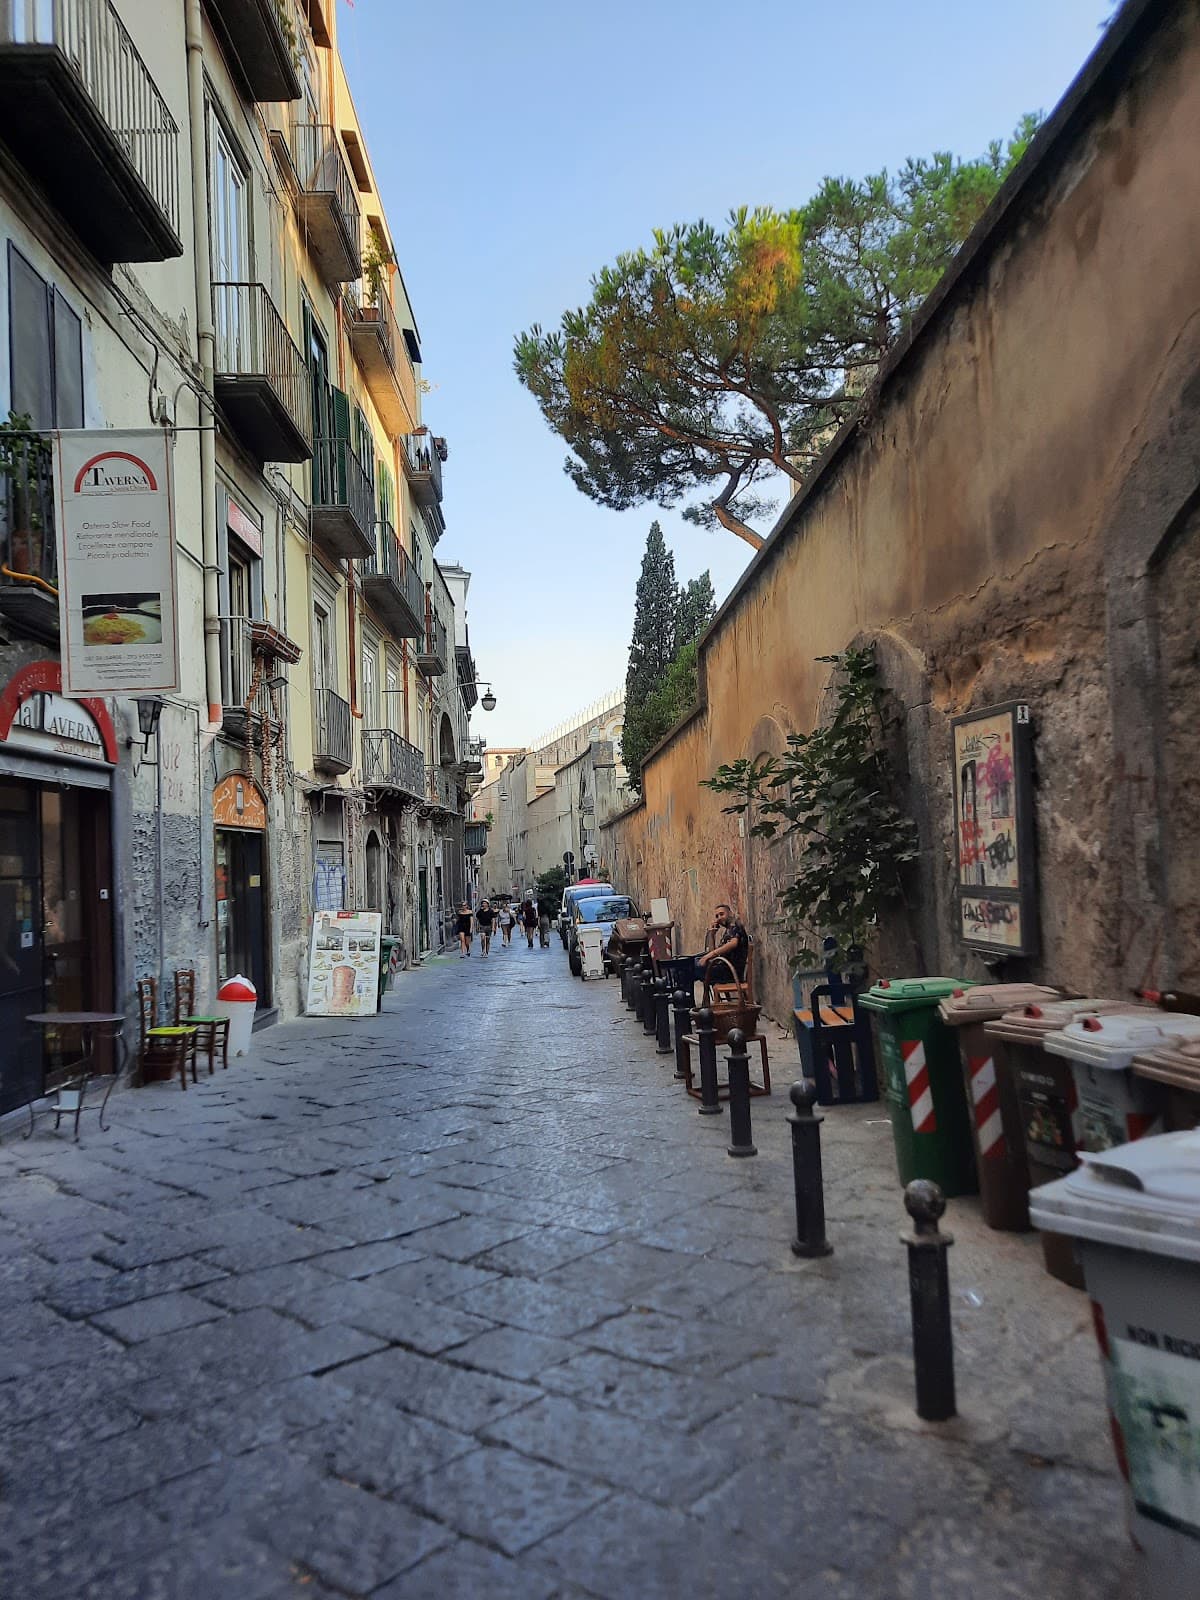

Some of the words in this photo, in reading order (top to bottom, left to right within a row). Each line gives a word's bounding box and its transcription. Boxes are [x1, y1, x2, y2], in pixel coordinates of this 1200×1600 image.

[87, 467, 149, 486] TAVERNA
[112, 521, 130, 529] Slow
[131, 520, 151, 528] Food
